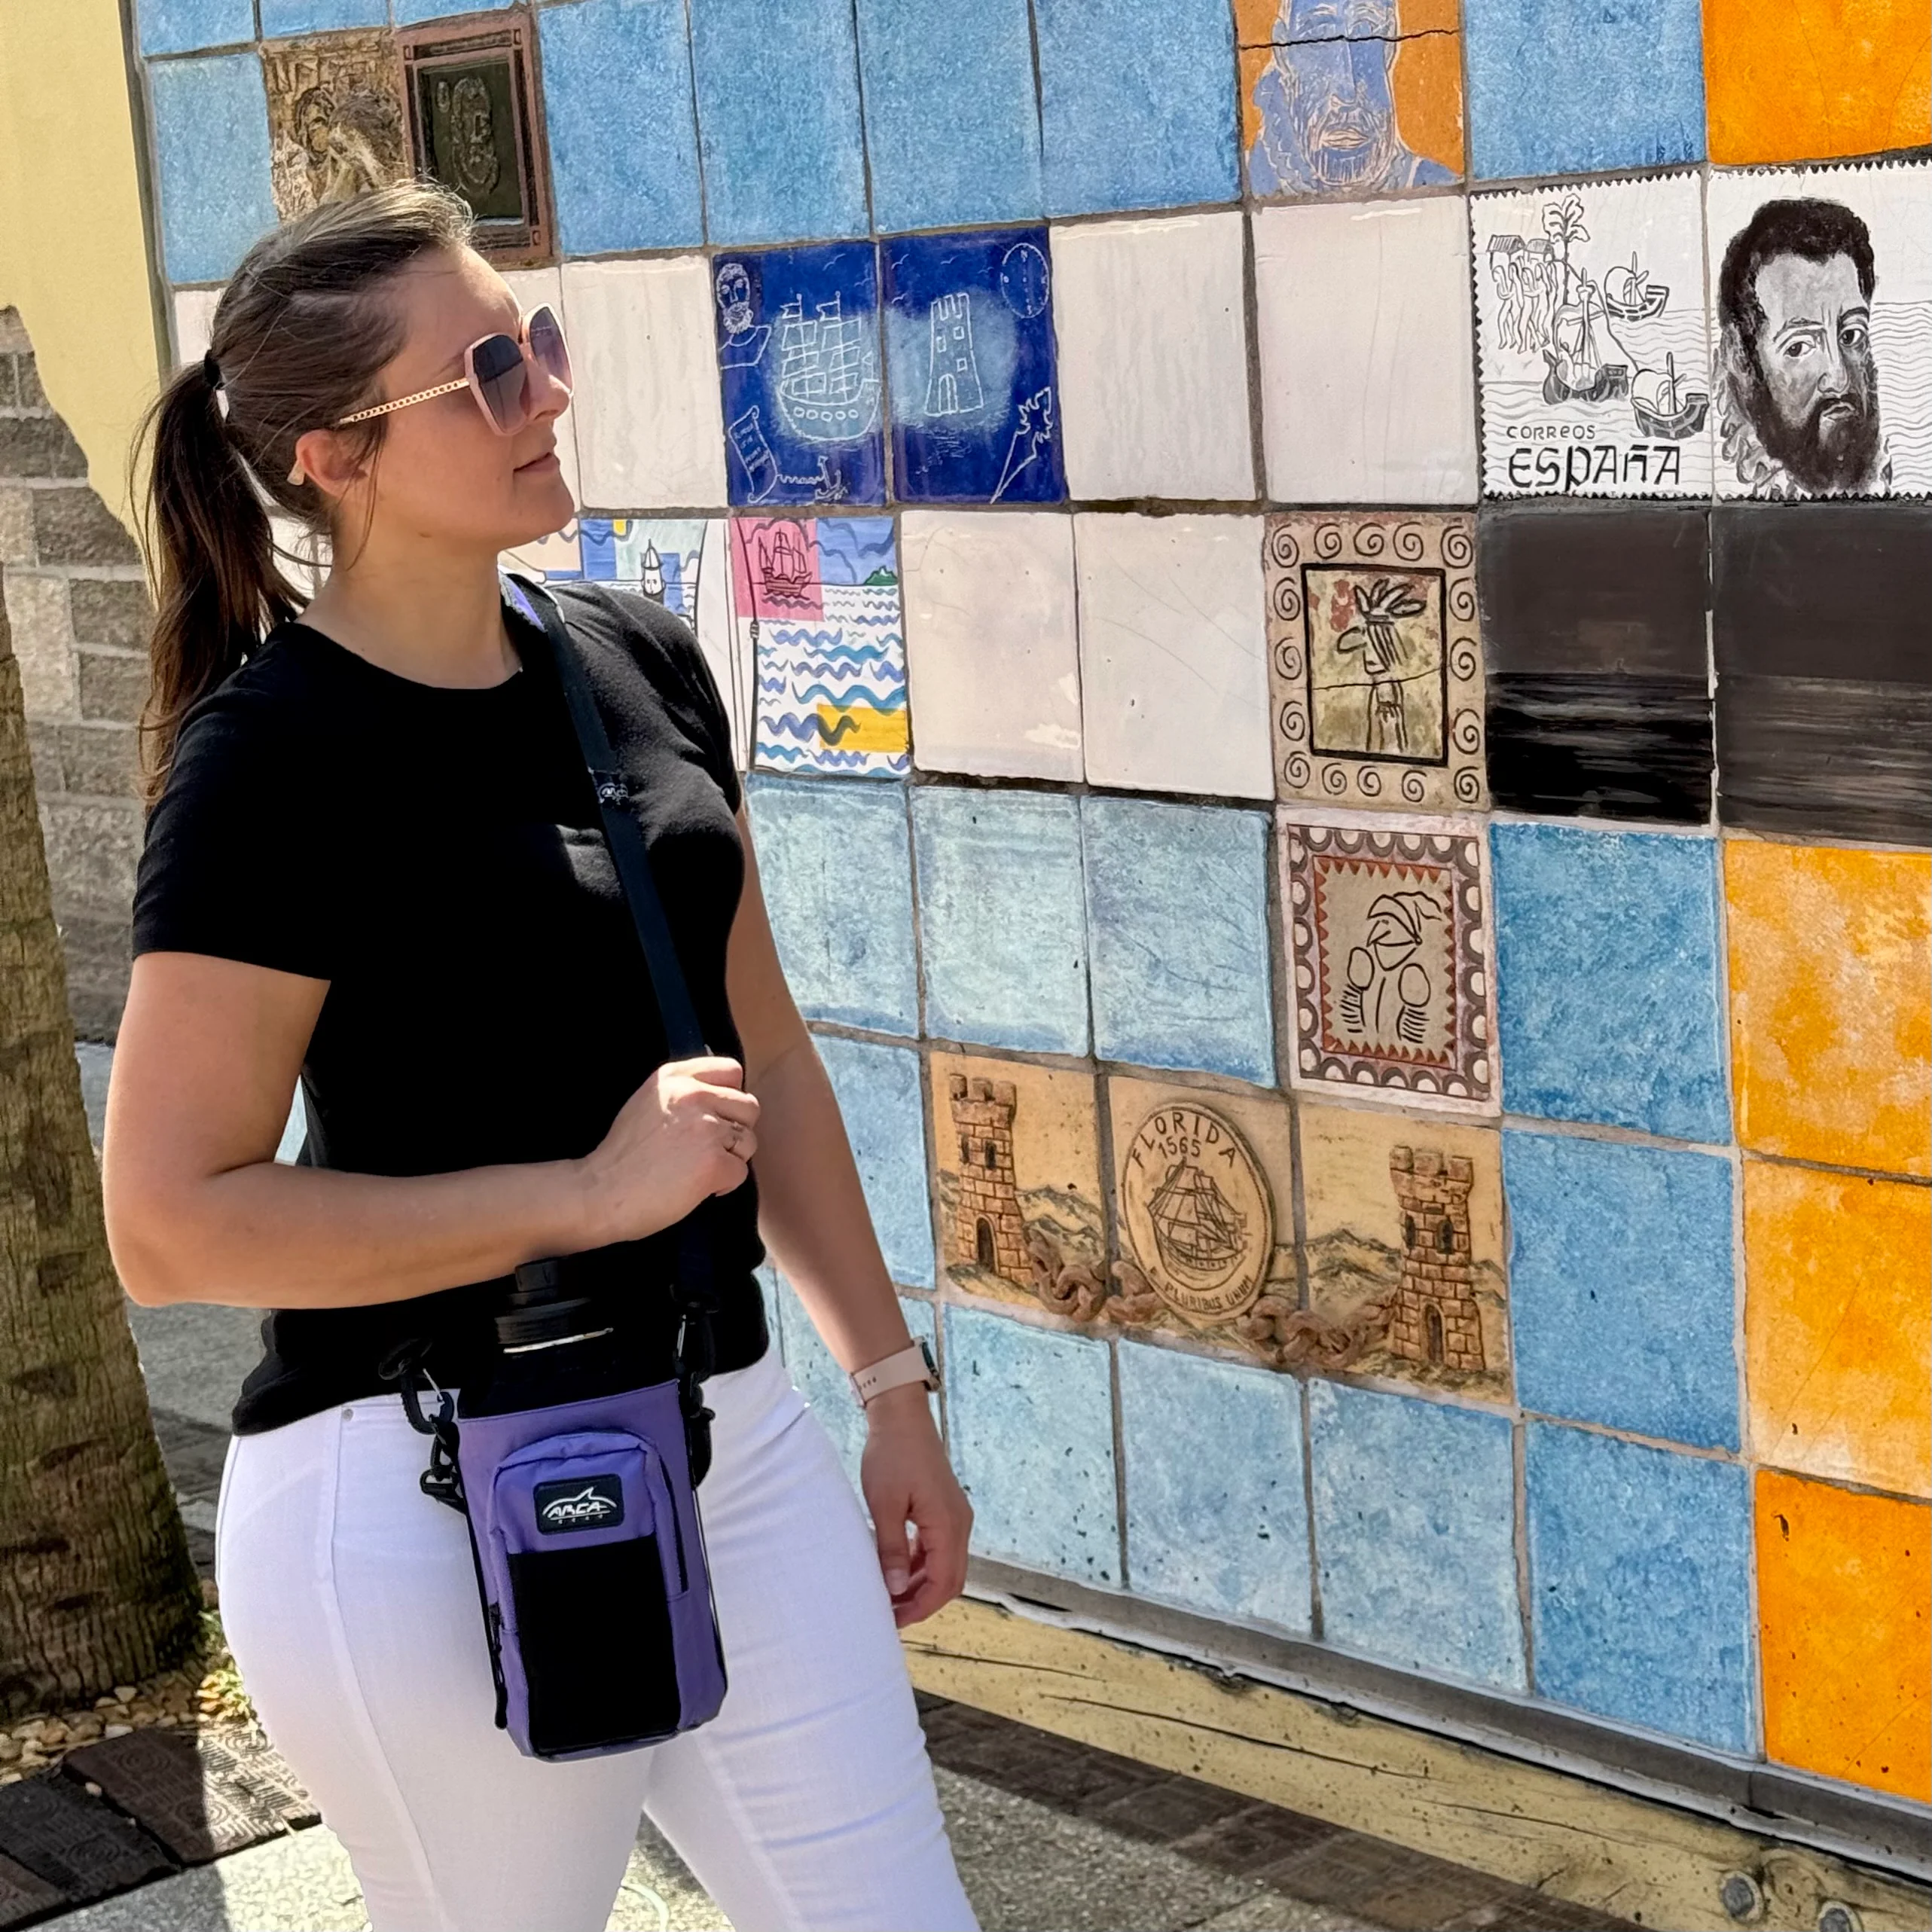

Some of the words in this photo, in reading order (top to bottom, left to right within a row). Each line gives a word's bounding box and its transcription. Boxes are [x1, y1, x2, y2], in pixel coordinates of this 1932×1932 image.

[1131, 1111, 1236, 1169] FLORIDA
[1158, 1136, 1201, 1159] 1565
[1164, 1281, 1222, 1309] PLURIBUS
